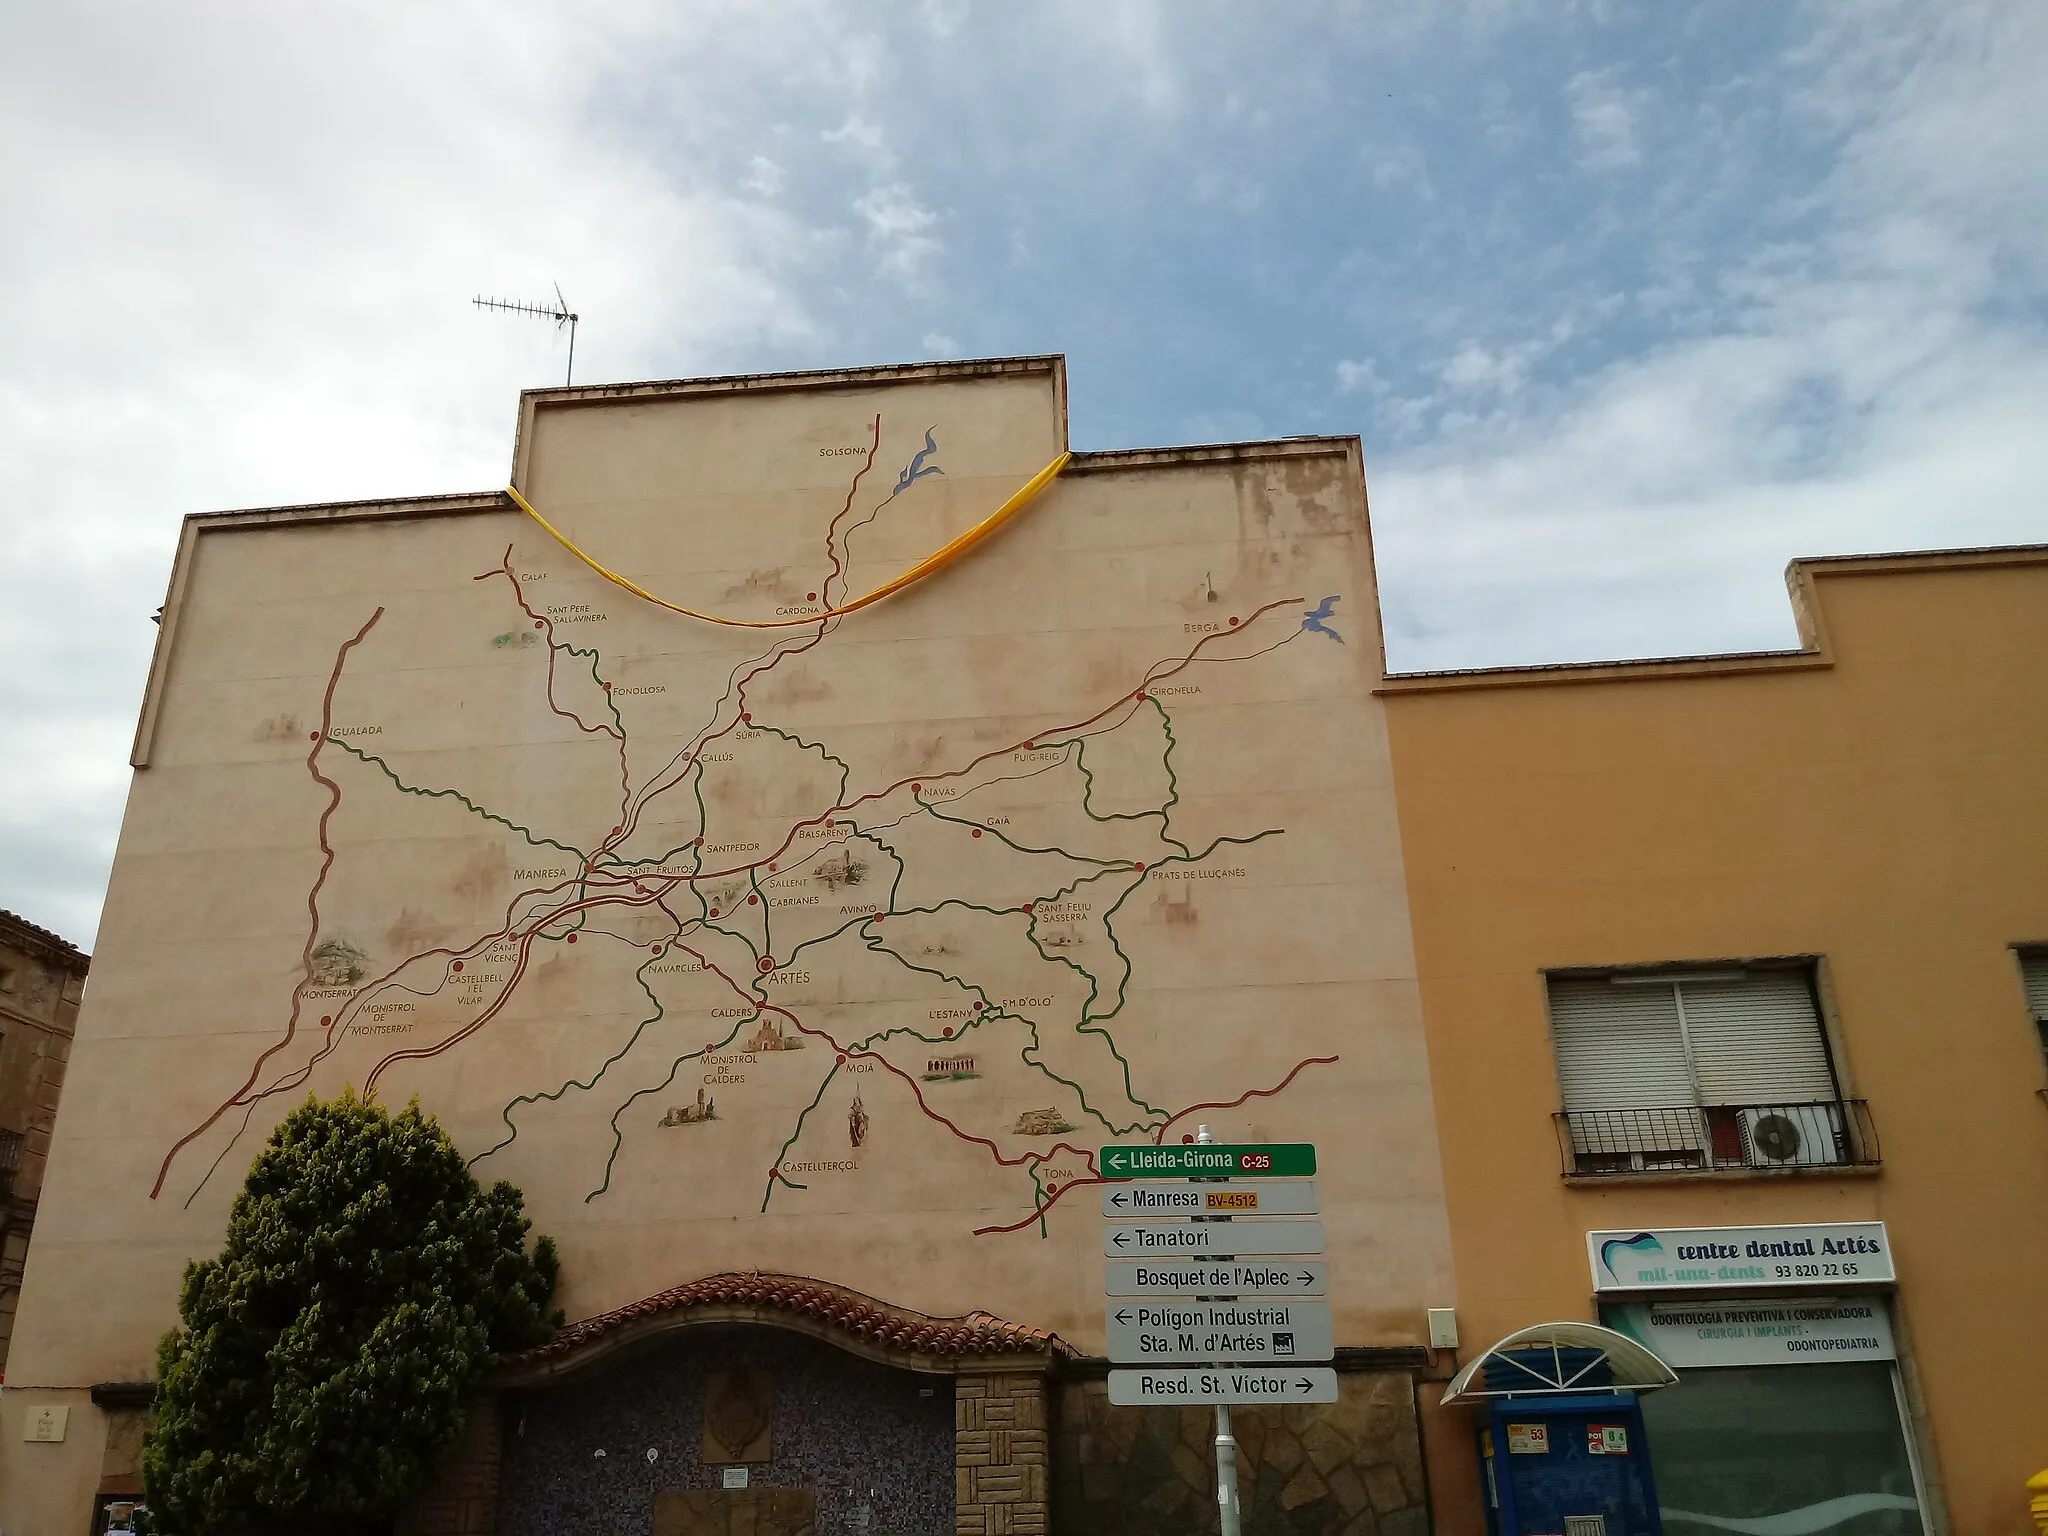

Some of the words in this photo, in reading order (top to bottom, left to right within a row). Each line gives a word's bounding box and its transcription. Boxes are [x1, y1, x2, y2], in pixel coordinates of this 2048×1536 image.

[819, 447, 867, 457] SOLSONA
[521, 573, 548, 582] CALAF
[547, 606, 568, 614] SANT
[570, 605, 589, 613] PERE
[775, 606, 820, 616] CARDONA
[554, 614, 607, 624] SALLAVINERA
[1184, 623, 1220, 633] BERGA
[613, 686, 666, 696] FONOLLOSA
[1149, 686, 1201, 696] GIRONELLA
[329, 726, 383, 737] IGUALADA
[735, 731, 762, 740] SÚRIA
[701, 752, 734, 762] CALLÚS
[1014, 752, 1060, 762] PUIG-REIG
[799, 829, 849, 839] BALSARENY
[706, 843, 760, 854] SANTPEDOR
[513, 868, 567, 880] MANRESA
[627, 867, 650, 875] SANT
[656, 864, 694, 874] FRUITÓS
[1152, 871, 1180, 880] PRATS
[1183, 870, 1196, 879] DE
[769, 878, 808, 888] SALLENT
[769, 897, 820, 908] CABRIANES
[1038, 904, 1063, 913] SANT
[1067, 902, 1092, 911] FELIU
[839, 903, 877, 915] AVINYÓ
[1043, 912, 1088, 922] SASSERRA
[492, 943, 517, 952] SANT
[484, 953, 518, 964] VICENÇ
[648, 963, 702, 974] NAVARCLES
[448, 974, 503, 984] CASTELLBELL
[768, 970, 810, 985] ARTÉS
[473, 984, 484, 992] EL
[300, 989, 358, 999] MONTSERRAT
[361, 1003, 416, 1013] MONISTROL
[711, 1008, 752, 1018] CALDERS
[373, 1013, 385, 1022] DE
[929, 1009, 972, 1019] L'ESTANY
[351, 1024, 413, 1036] MONTSERRAT
[700, 1055, 757, 1065] MONISTROL
[717, 1066, 730, 1074] DE
[846, 1063, 874, 1073] MOIÀ
[703, 1075, 745, 1084] CALDERS
[1130, 1151, 1233, 1169] Lleida-Girona
[1241, 1156, 1270, 1168] C-25
[783, 1161, 858, 1173] CASTELLTERÇOL
[1043, 1168, 1073, 1179] TONA
[1133, 1190, 1199, 1207] Manresa
[1206, 1194, 1257, 1207] BV-4512
[1135, 1229, 1210, 1247] Tanatori
[1677, 1243, 1740, 1260] centre
[1746, 1238, 1816, 1258] dental
[1821, 1234, 1881, 1255] Artés
[1775, 1265, 1792, 1278] 93
[1795, 1264, 1819, 1277] 820
[1823, 1263, 1839, 1276] 22
[1842, 1262, 1859, 1275] 65
[1136, 1268, 1205, 1289] Bosquet
[1209, 1268, 1230, 1285] de
[1234, 1268, 1290, 1289] l'Aplec
[1138, 1308, 1204, 1330] Polígon
[1209, 1307, 1290, 1326] Industrial
[1651, 1311, 1723, 1326] ODONTOLOGIA
[1725, 1309, 1785, 1323] PREVENTIVA
[1787, 1310, 1792, 1321] I
[1794, 1307, 1873, 1321] CONSERVADORA
[1697, 1327, 1745, 1340] CIRURGIA
[1754, 1325, 1802, 1338] IMPLANTS
[1140, 1334, 1173, 1353] Sta.
[1178, 1334, 1199, 1352] M.
[1204, 1332, 1266, 1352] d'Artés
[1787, 1337, 1880, 1352] ODONTOPEDIATRIA
[1141, 1376, 1194, 1395] Resd.
[1200, 1375, 1226, 1394] St.
[1231, 1373, 1287, 1394] Víctor
[1531, 1429, 1544, 1440] 53
